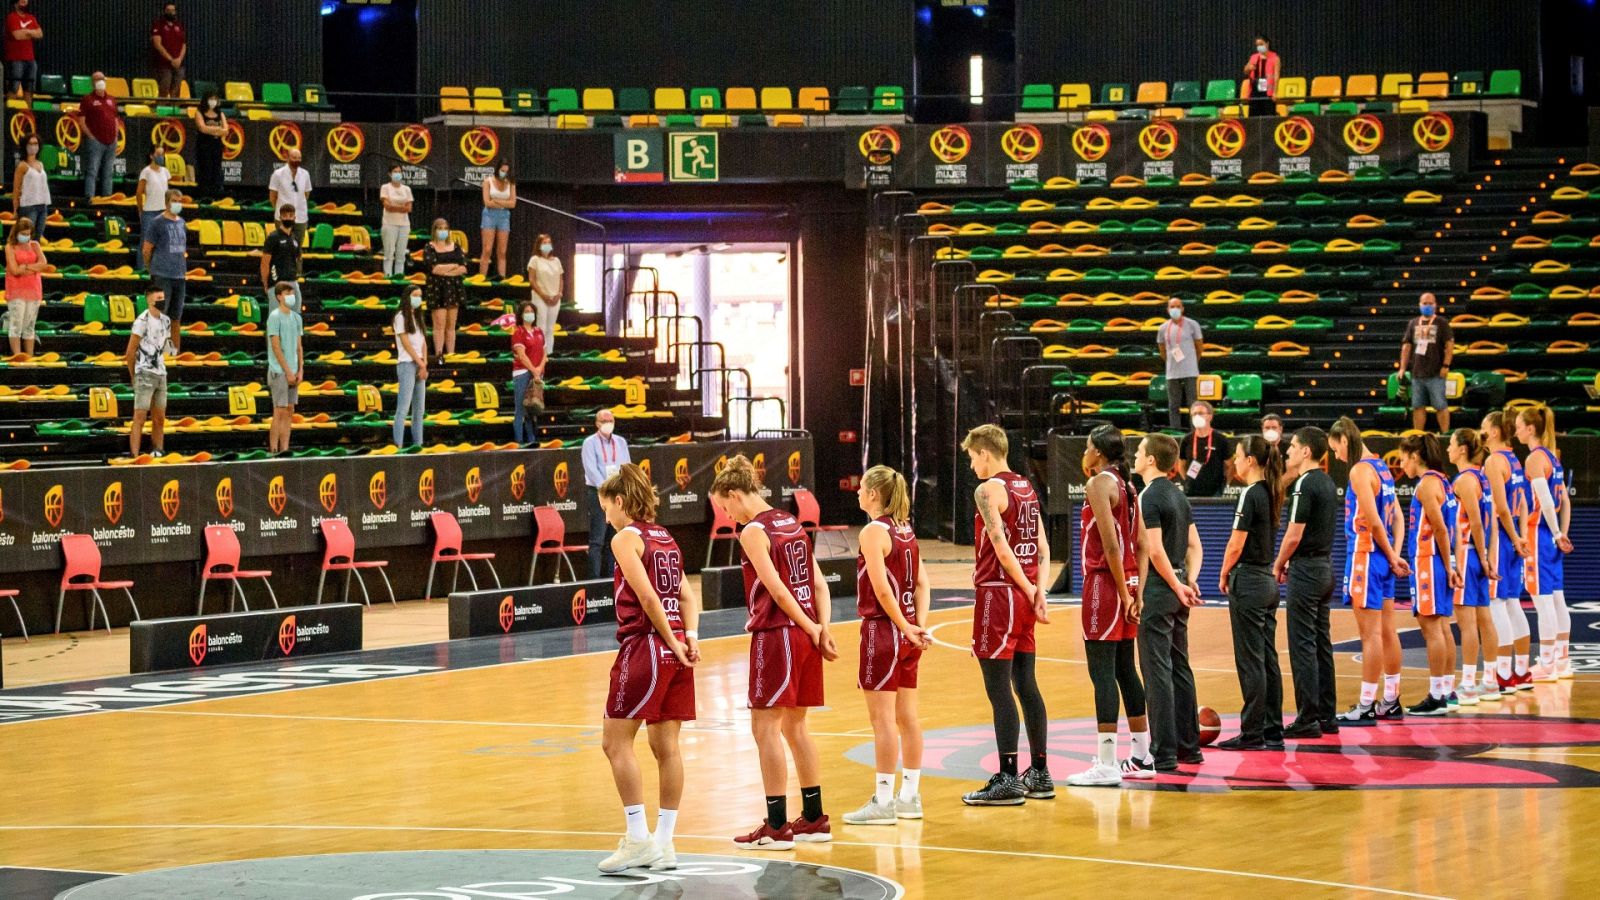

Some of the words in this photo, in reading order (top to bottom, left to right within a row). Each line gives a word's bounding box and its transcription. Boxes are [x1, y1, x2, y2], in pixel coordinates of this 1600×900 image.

[627, 139, 650, 170] B
[1279, 163, 1311, 172] MUJER
[1418, 159, 1451, 168] MUJER
[935, 170, 967, 178] MUJER
[1006, 169, 1038, 177] MUJER
[1076, 169, 1107, 177] MUJER
[1143, 168, 1174, 176] MUJER
[1210, 165, 1242, 174] MUJER
[1015, 500, 1040, 540] 45
[784, 539, 809, 585] 12
[653, 550, 681, 594] 66
